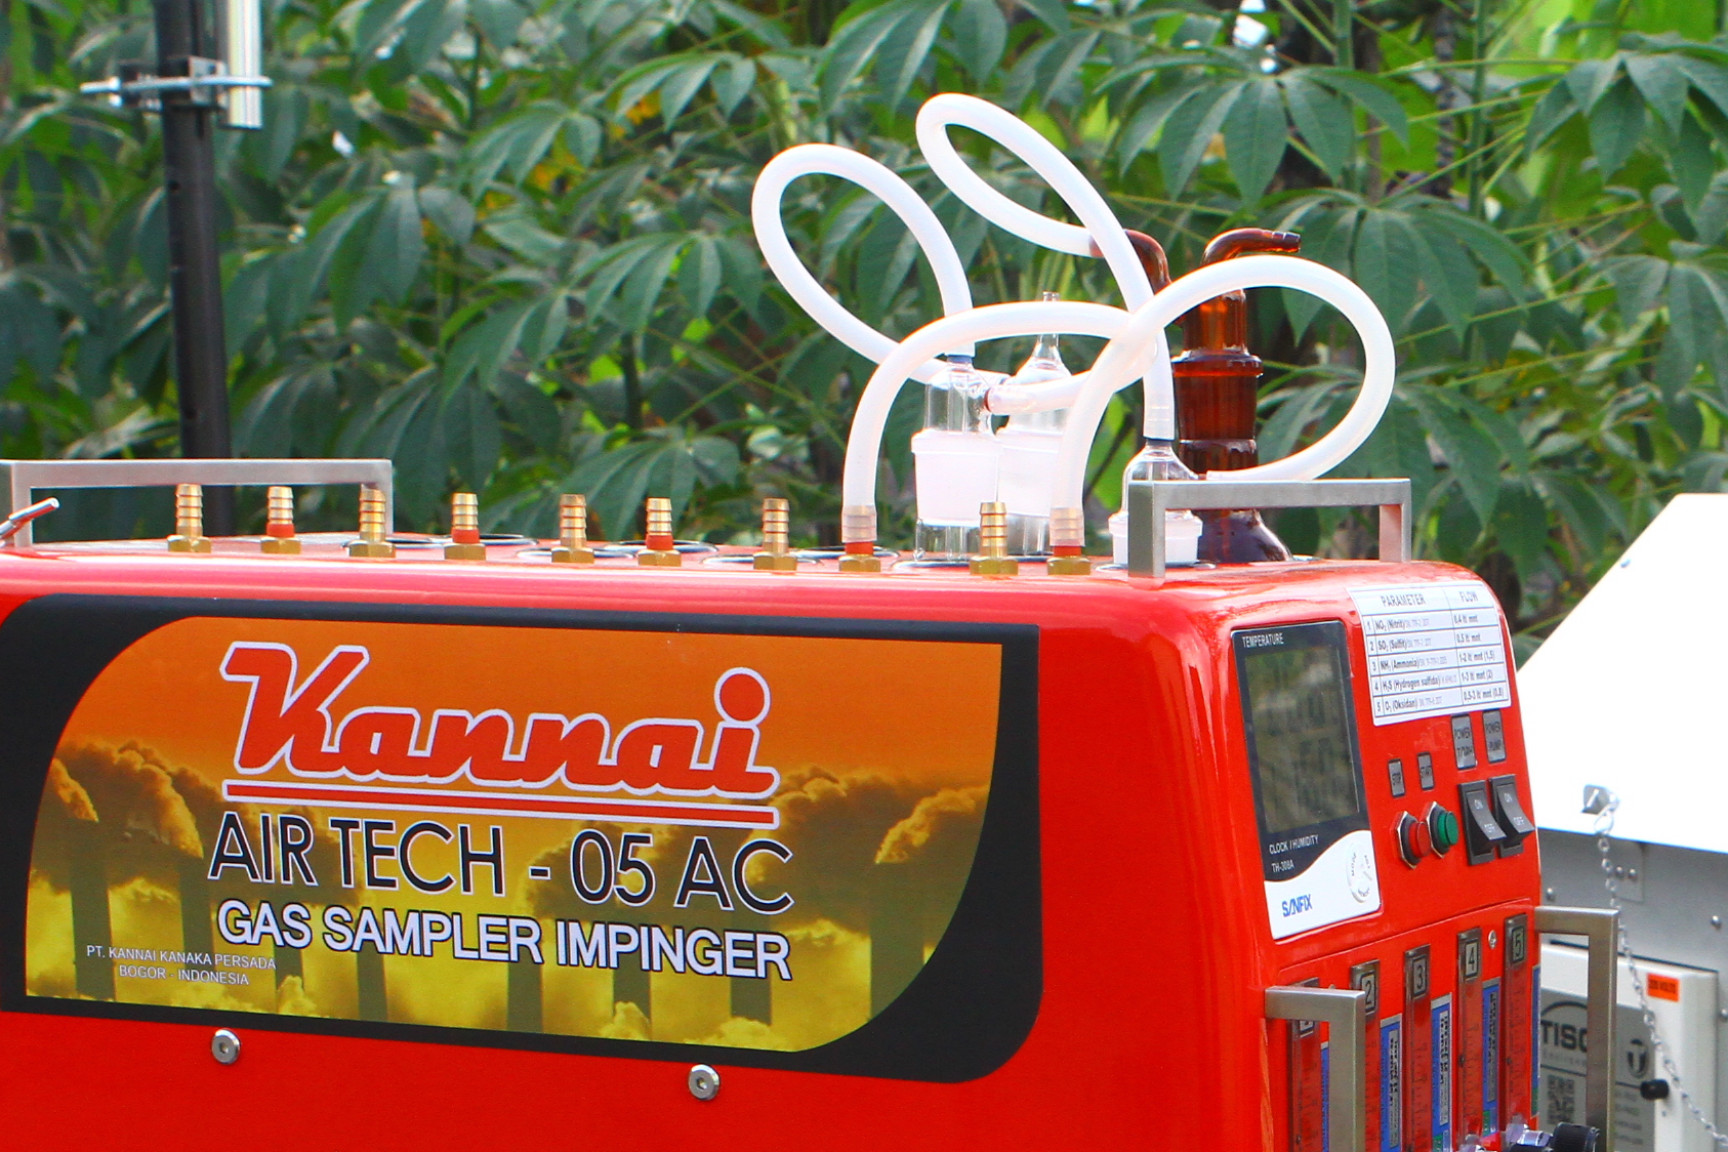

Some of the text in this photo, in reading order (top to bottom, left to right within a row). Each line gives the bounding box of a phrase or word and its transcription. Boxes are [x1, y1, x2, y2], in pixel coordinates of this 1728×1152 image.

[1380, 593, 1426, 607] PARAMETER
[1241, 632, 1284, 648] TEMPERATURE
[219, 640, 781, 800] Kannai
[1269, 842, 1289, 854] CLOCK
[207, 811, 319, 887] AIR
[328, 816, 506, 898] TECH
[570, 828, 656, 908] 05
[673, 836, 795, 916] AC
[216, 899, 793, 981] GAS SAMPLER IMPINGER
[1514, 934, 1522, 959] 5
[86, 945, 277, 970] PT. KANNAI KANAKA PERSADA
[1467, 943, 1476, 969] 4
[119, 964, 167, 980] BOGOR
[178, 969, 250, 985] INDONESIA
[1416, 964, 1425, 991] 3
[1364, 980, 1372, 1003] 2
[1540, 1019, 1588, 1053] TISC
